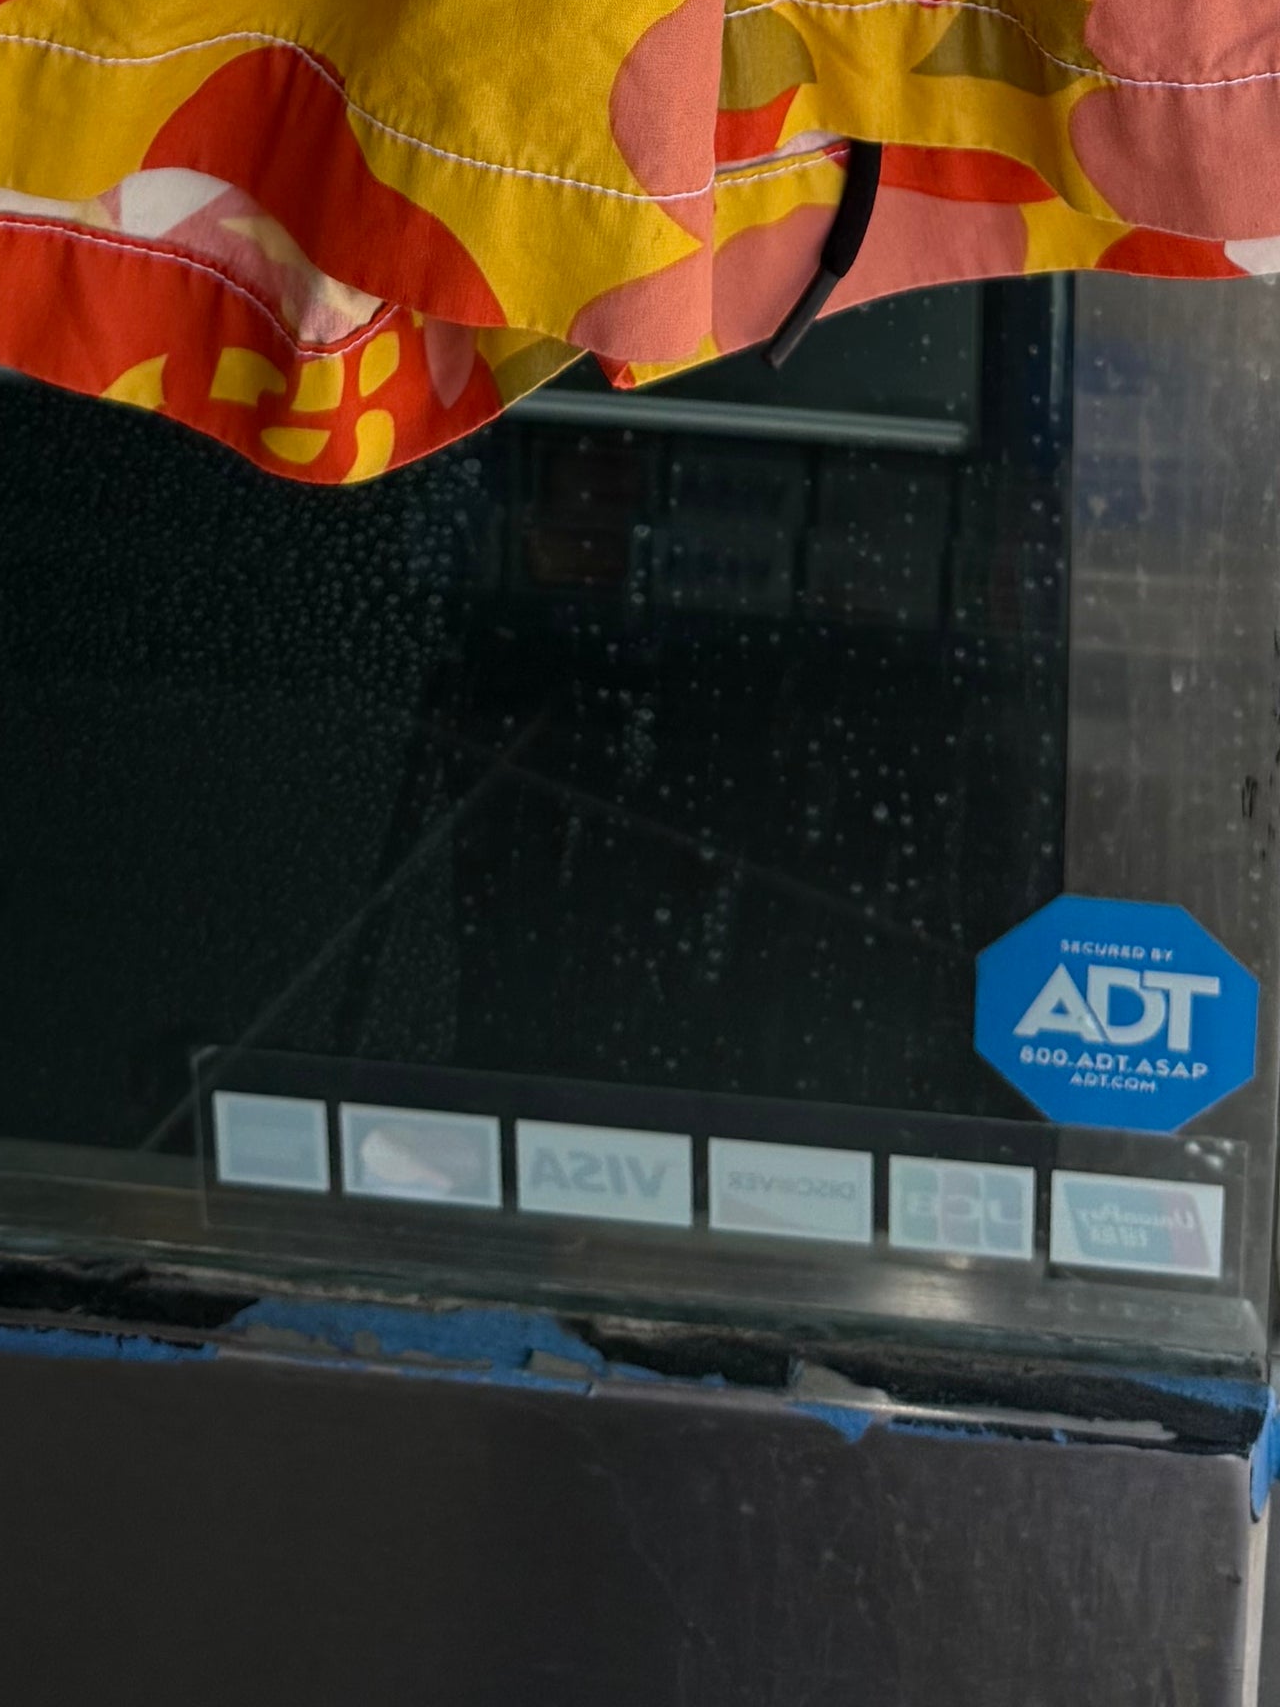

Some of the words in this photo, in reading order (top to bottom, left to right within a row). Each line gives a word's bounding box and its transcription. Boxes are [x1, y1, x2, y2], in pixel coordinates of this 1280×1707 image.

[1060, 939, 1144, 961] SECURED
[1012, 962, 1220, 1053] ADT
[1069, 1072, 1156, 1093] ADT.COM
